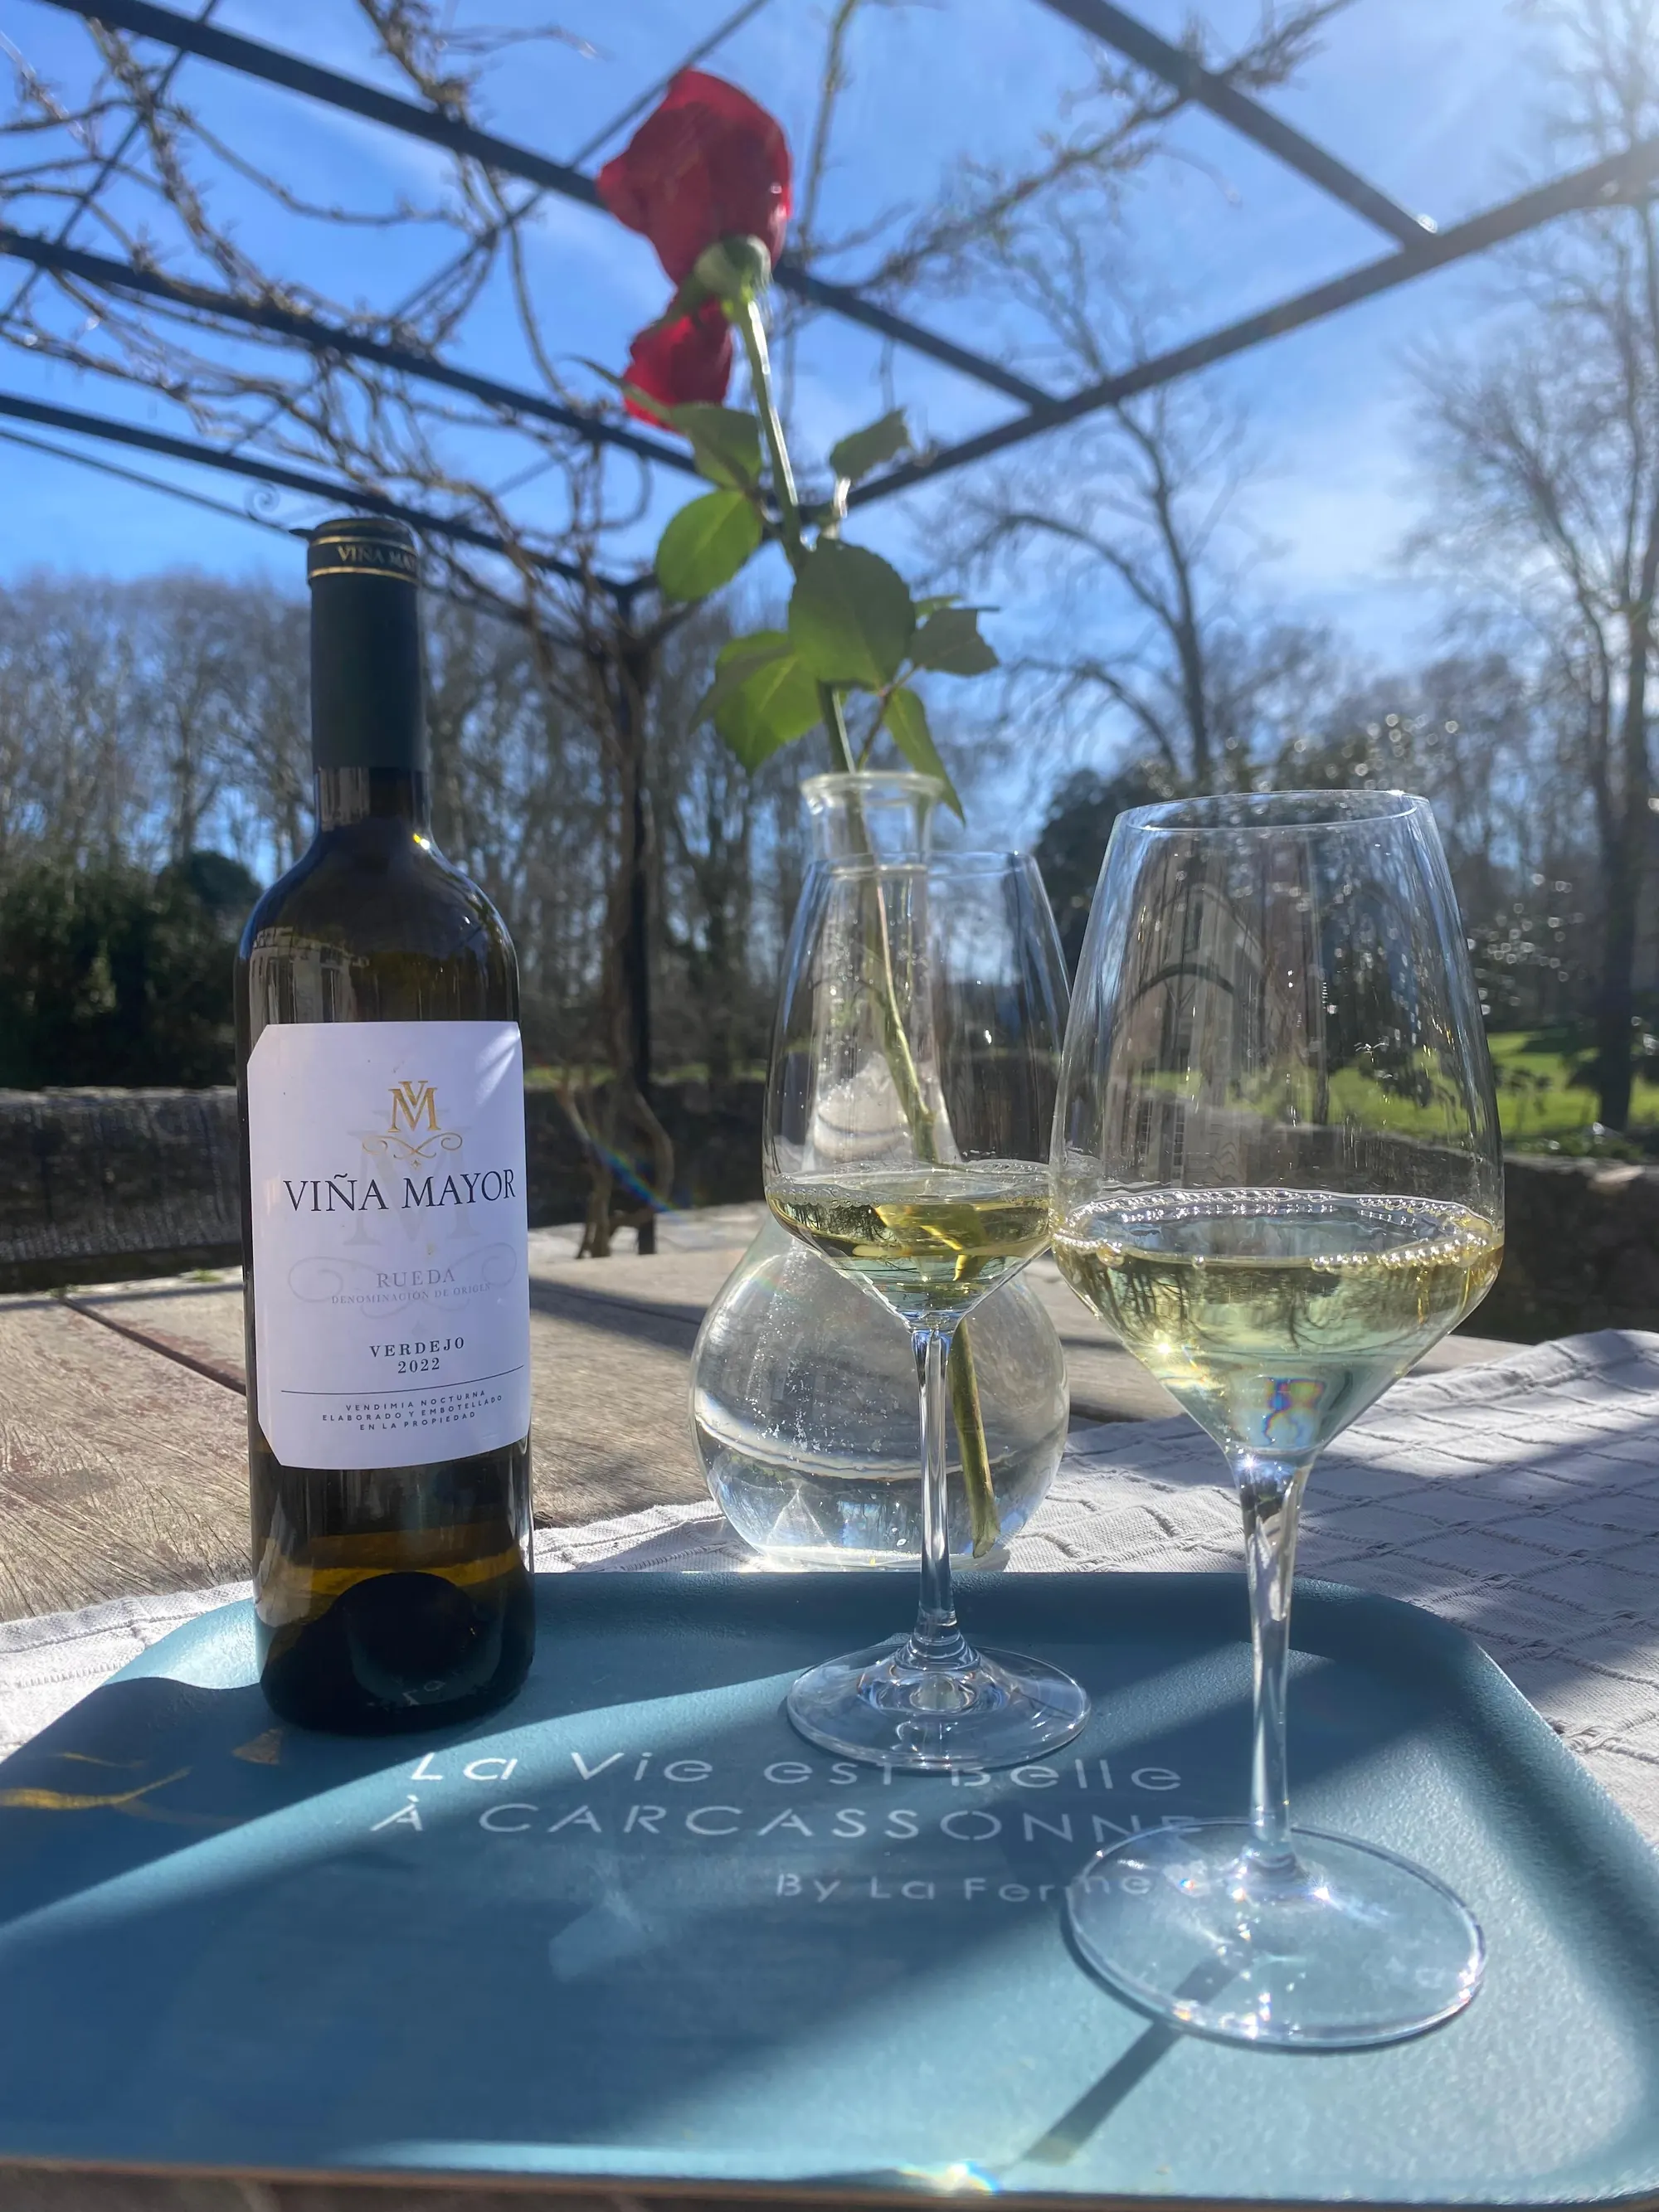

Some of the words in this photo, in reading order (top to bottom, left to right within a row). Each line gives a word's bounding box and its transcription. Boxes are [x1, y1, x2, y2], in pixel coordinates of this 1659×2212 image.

[283, 1173, 389, 1212] VIÑA
[401, 1169, 516, 1209] MAYOR
[377, 1267, 455, 1289] RUEDA
[331, 1290, 430, 1305] DENOMINACIÓN
[435, 1288, 450, 1298] DE
[453, 1282, 492, 1296] ORIGEN
[370, 1336, 465, 1358] VERDEJO
[397, 1357, 440, 1374] 2022
[322, 1412, 401, 1422] ELABORADO
[421, 1395, 503, 1417] EMBOTELLADO
[345, 1401, 414, 1412] VENDIMIA
[421, 1390, 485, 1407] NOCTURNA
[404, 1411, 476, 1428] PROPIEDAD
[411, 1752, 518, 1782] La
[571, 1752, 713, 1782] Vie
[371, 1795, 424, 1831] À
[776, 1874, 841, 1903] By
[870, 1877, 935, 1901] La
